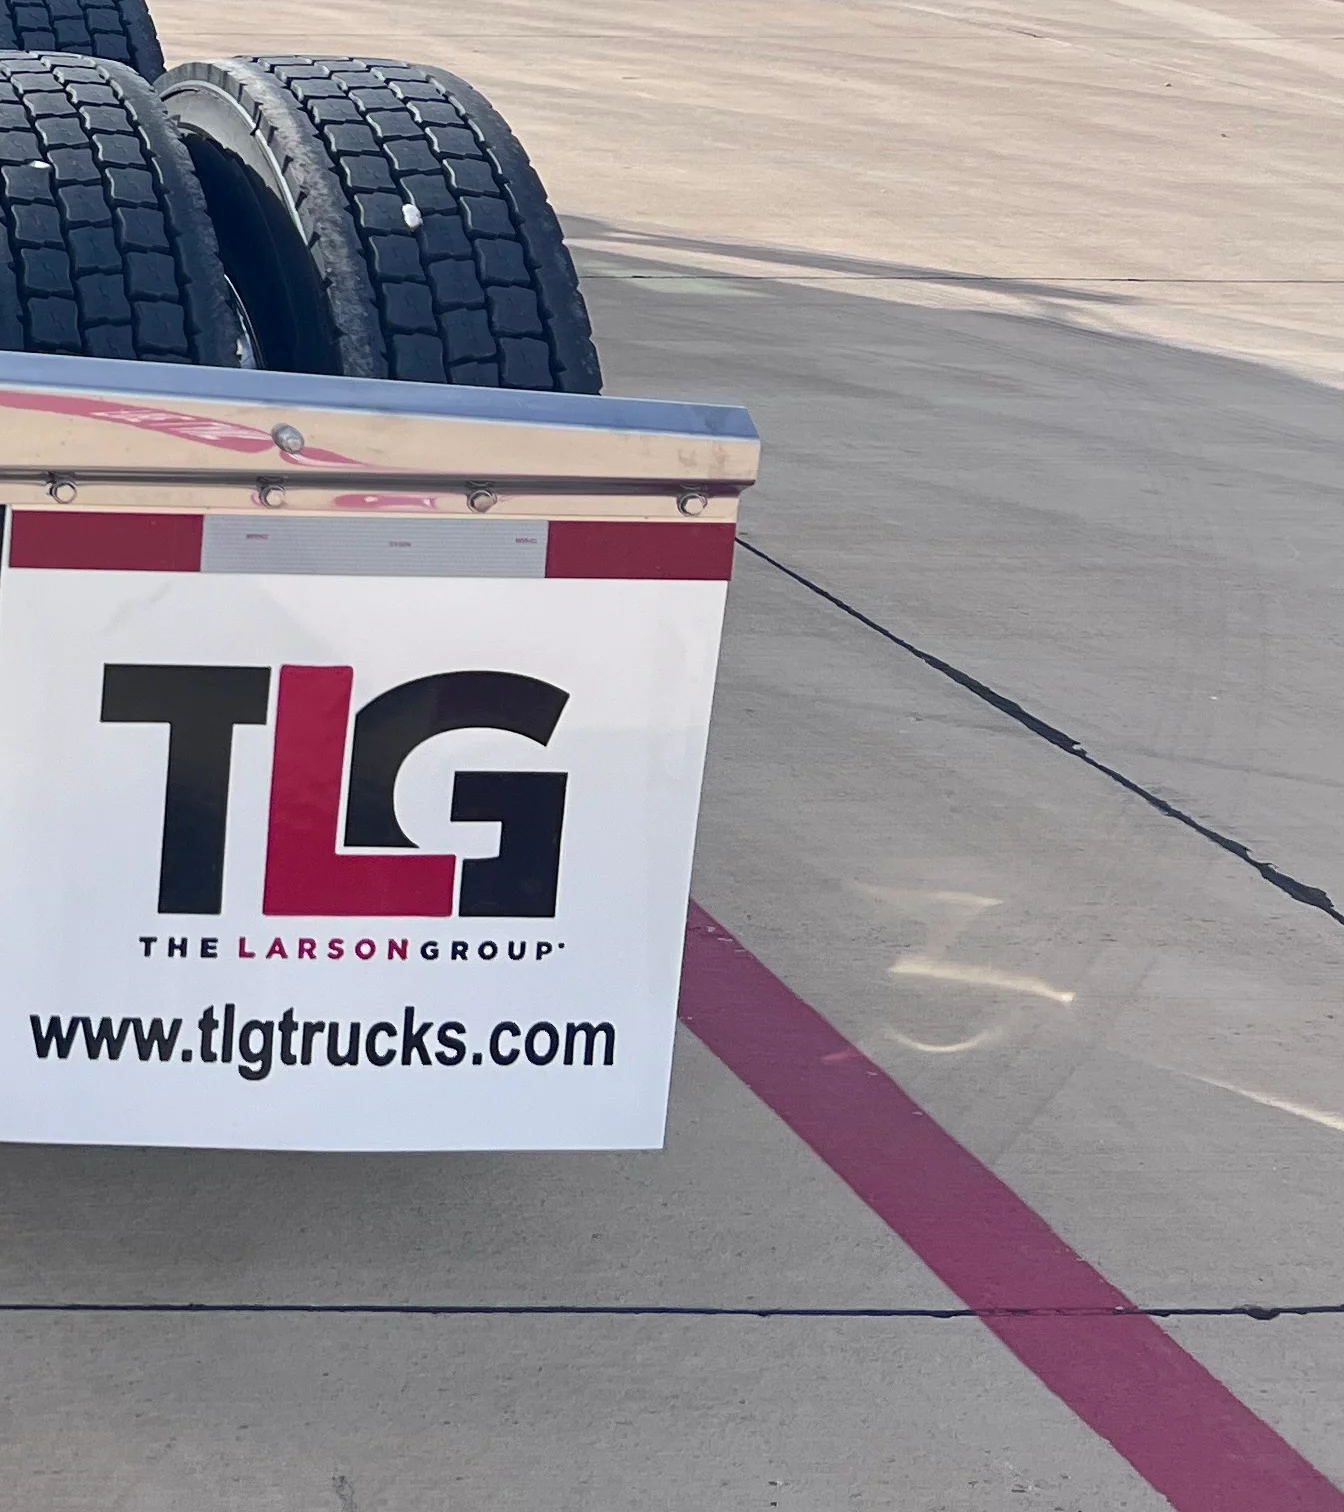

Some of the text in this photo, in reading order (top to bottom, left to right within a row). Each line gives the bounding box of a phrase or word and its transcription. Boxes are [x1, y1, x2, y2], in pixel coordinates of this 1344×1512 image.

[100, 663, 569, 918] TLG
[139, 937, 219, 959] THE
[30, 1003, 616, 1081] www.tlgtrucks.com
